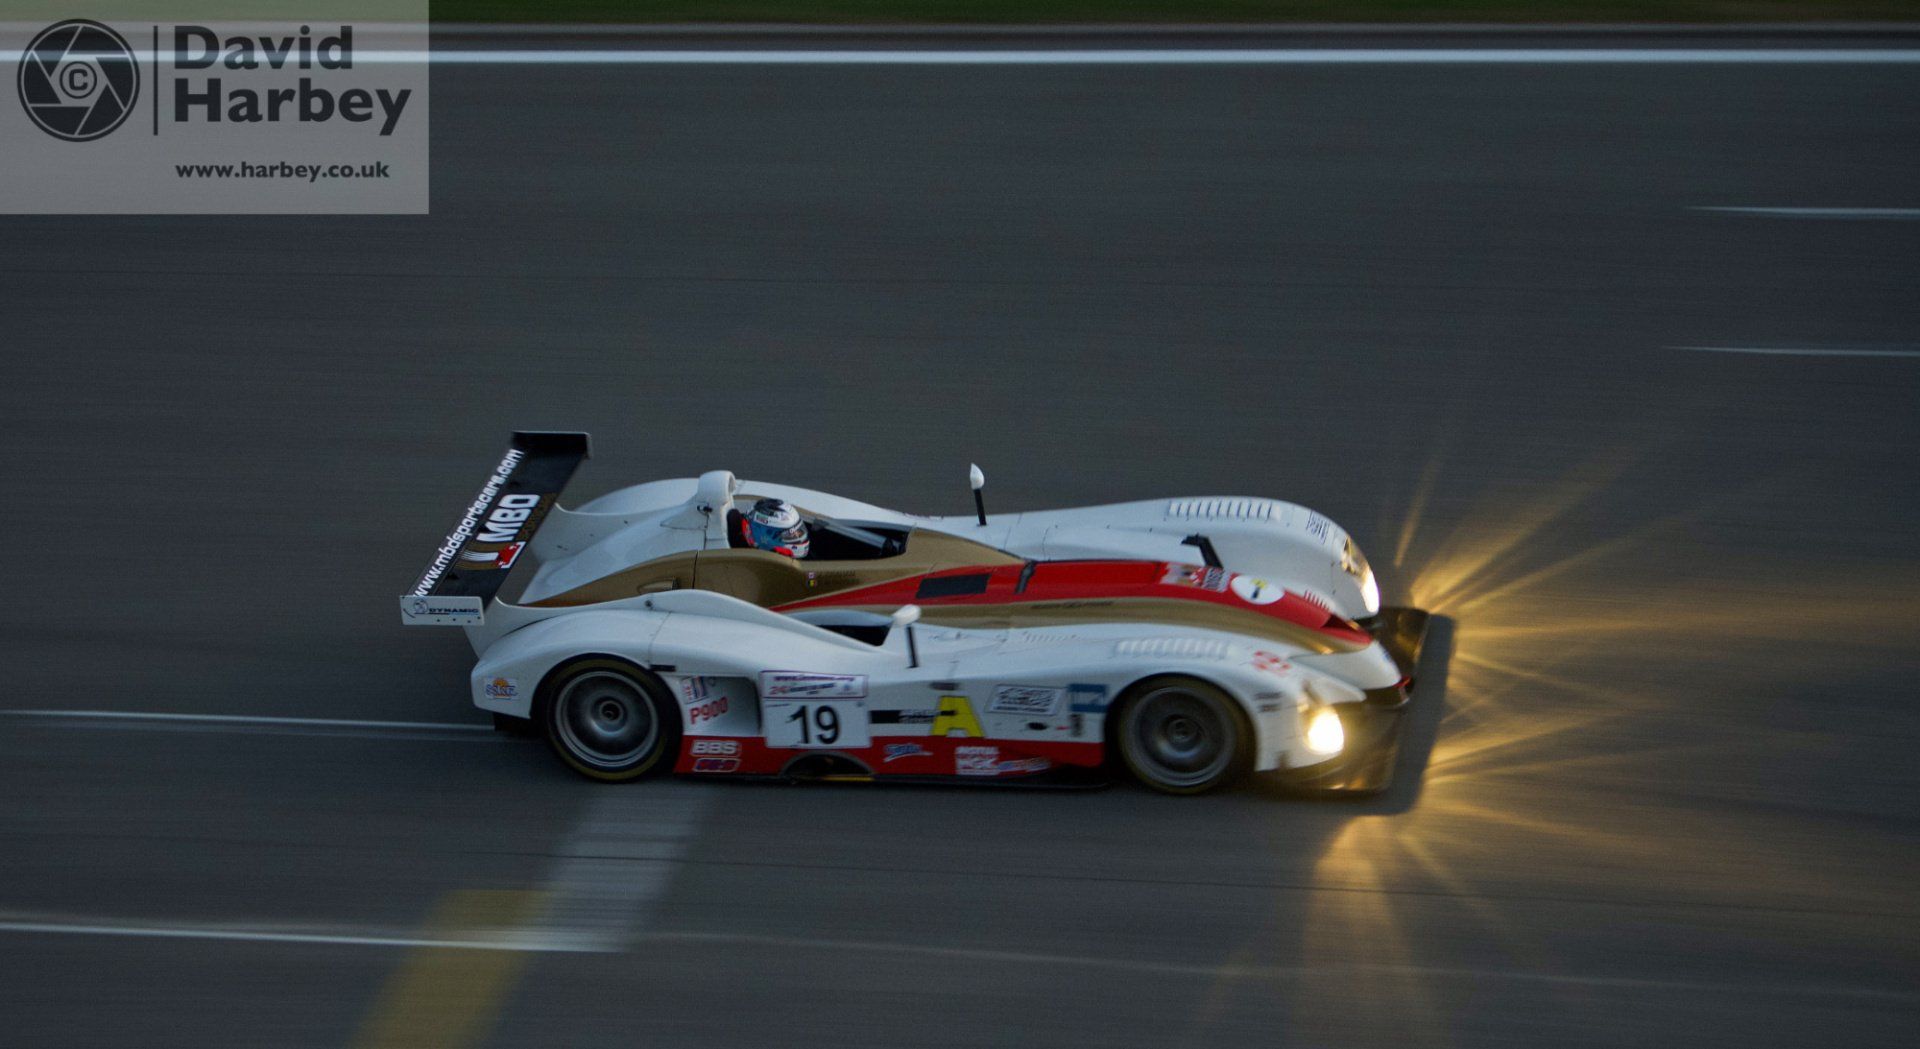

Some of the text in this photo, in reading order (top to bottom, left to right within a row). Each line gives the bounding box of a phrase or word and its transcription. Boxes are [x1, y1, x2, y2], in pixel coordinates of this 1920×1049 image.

[690, 697, 729, 724] P900
[786, 705, 841, 744] 19
[691, 740, 738, 754] BBS
